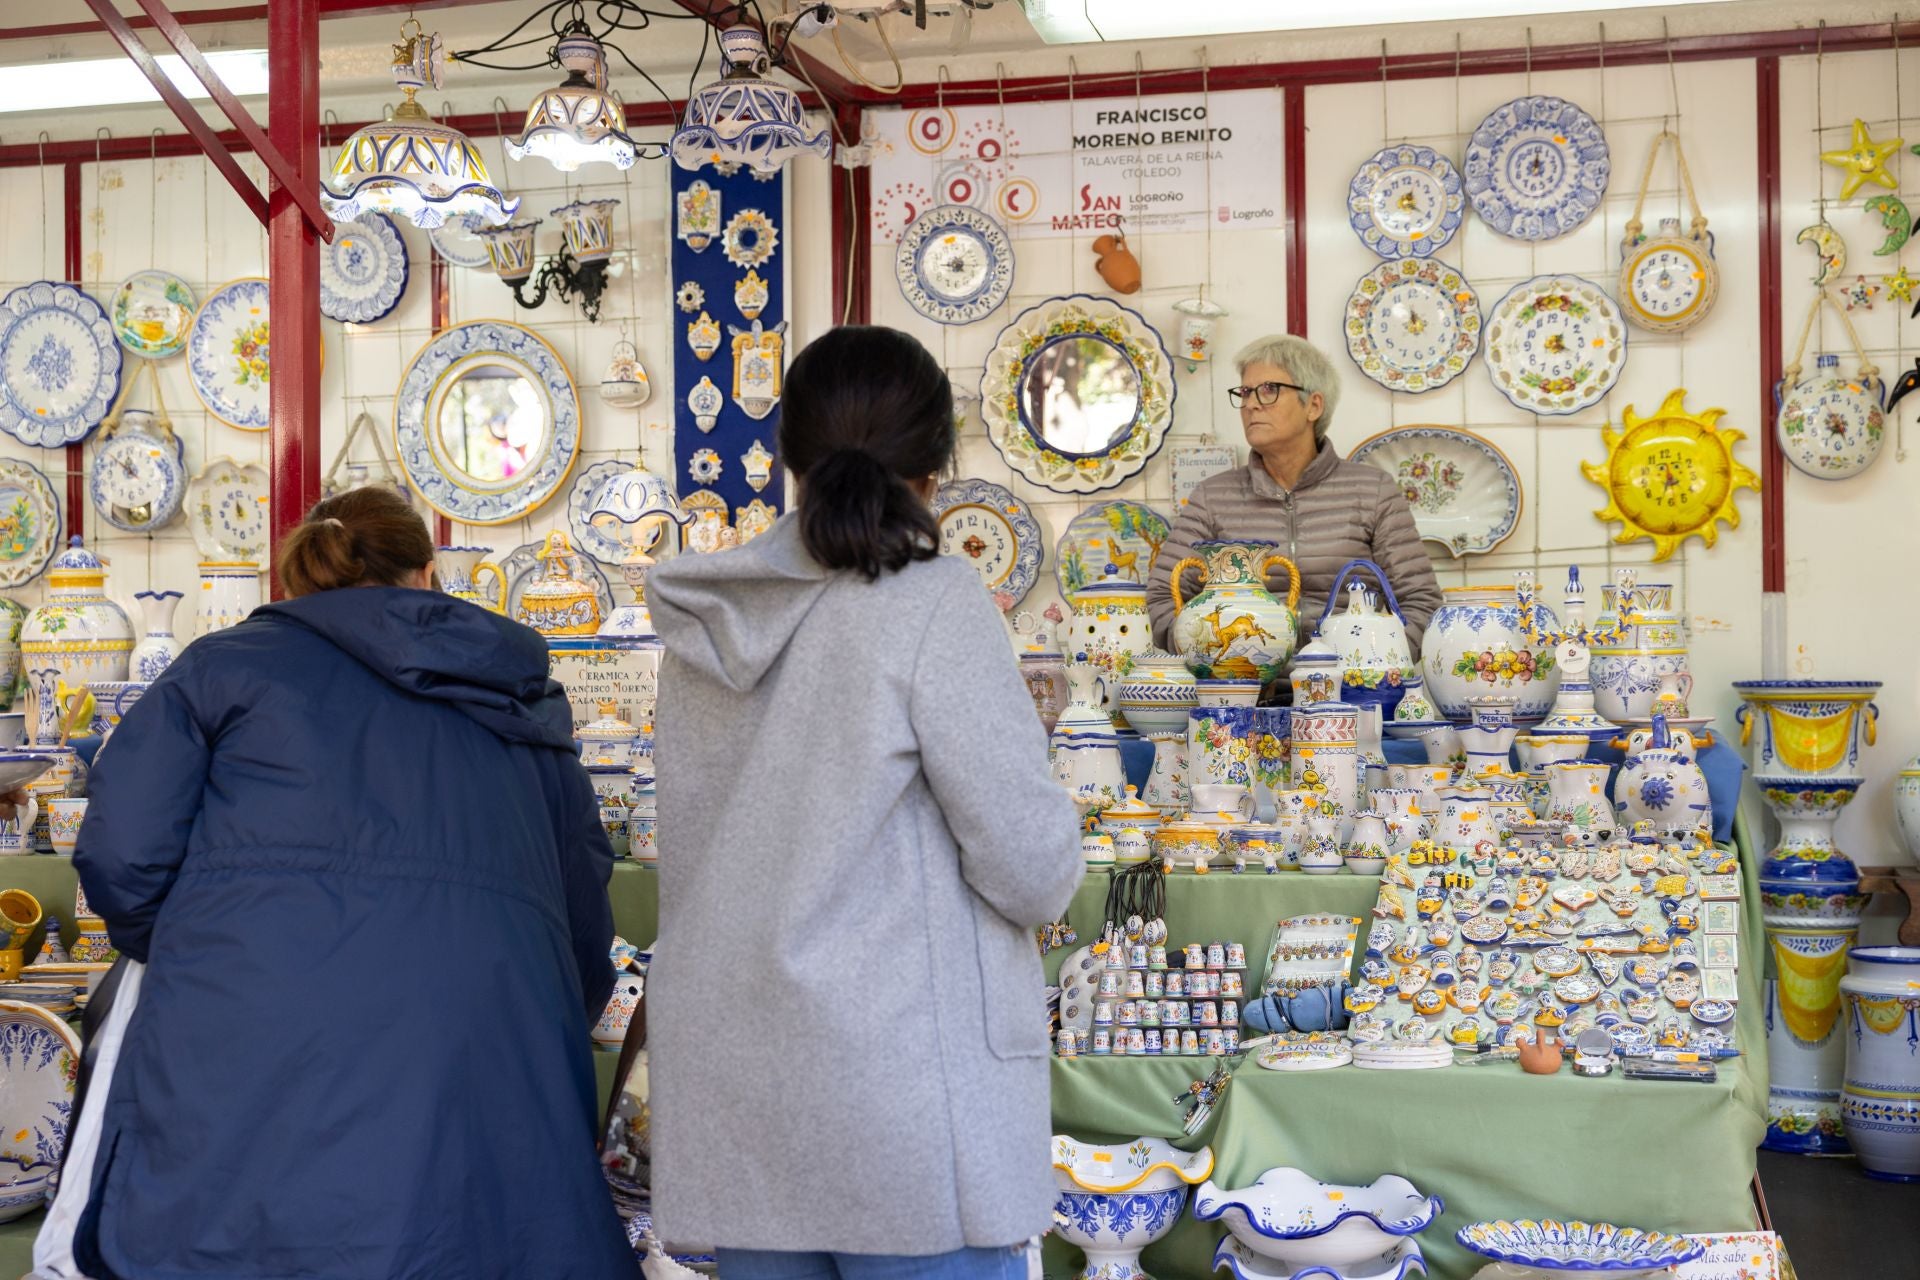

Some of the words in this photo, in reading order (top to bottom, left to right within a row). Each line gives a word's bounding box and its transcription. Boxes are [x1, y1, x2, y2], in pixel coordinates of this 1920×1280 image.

[1096, 106, 1207, 125] FRANCISCO
[1072, 132, 1155, 148] MORENO
[1161, 128, 1232, 144] BENITO
[1081, 154, 1143, 167] TALAVERA
[1147, 154, 1164, 164] DE
[1167, 152, 1183, 162] LA
[1186, 150, 1223, 162] REINA
[1122, 168, 1181, 180] (TOLEDO)
[1402, 176, 1412, 185] 12
[1080, 184, 1121, 212] SAN
[1129, 192, 1184, 203] LOGROÑO
[1233, 207, 1274, 220] Logroño
[1052, 214, 1121, 230] MATEO
[1652, 300, 1658, 309] 7
[1662, 302, 1668, 311] 6
[1547, 313, 1558, 324] 12
[1564, 317, 1568, 326] 1
[1380, 322, 1388, 332] 9
[1573, 324, 1581, 334] 2
[1524, 341, 1532, 352] 9
[1578, 336, 1584, 348] 3
[1529, 354, 1536, 366] 8
[1564, 360, 1572, 370] 5
[1552, 365, 1560, 376] 6
[1660, 449, 1670, 458] 12
[1179, 457, 1228, 466] Bienvenido
[1686, 458, 1692, 468] 2
[1656, 496, 1662, 506] 7
[1668, 498, 1675, 506] 6
[1680, 493, 1688, 504] 5
[956, 518, 962, 530] 11
[968, 515, 978, 526] 12
[984, 519, 988, 529] 1
[946, 528, 954, 538] 10
[991, 524, 999, 536] 2
[944, 543, 950, 554] 9
[997, 538, 1004, 550] 3
[994, 552, 1002, 564] 4
[986, 562, 992, 573] 5
[579, 670, 628, 680] CERAMICA
[561, 682, 610, 694] RANCISCO
[613, 682, 654, 693] MORENO
[569, 696, 618, 704] TALAVER
[1696, 1250, 1720, 1264] Más
[1722, 1249, 1746, 1263] sabe
